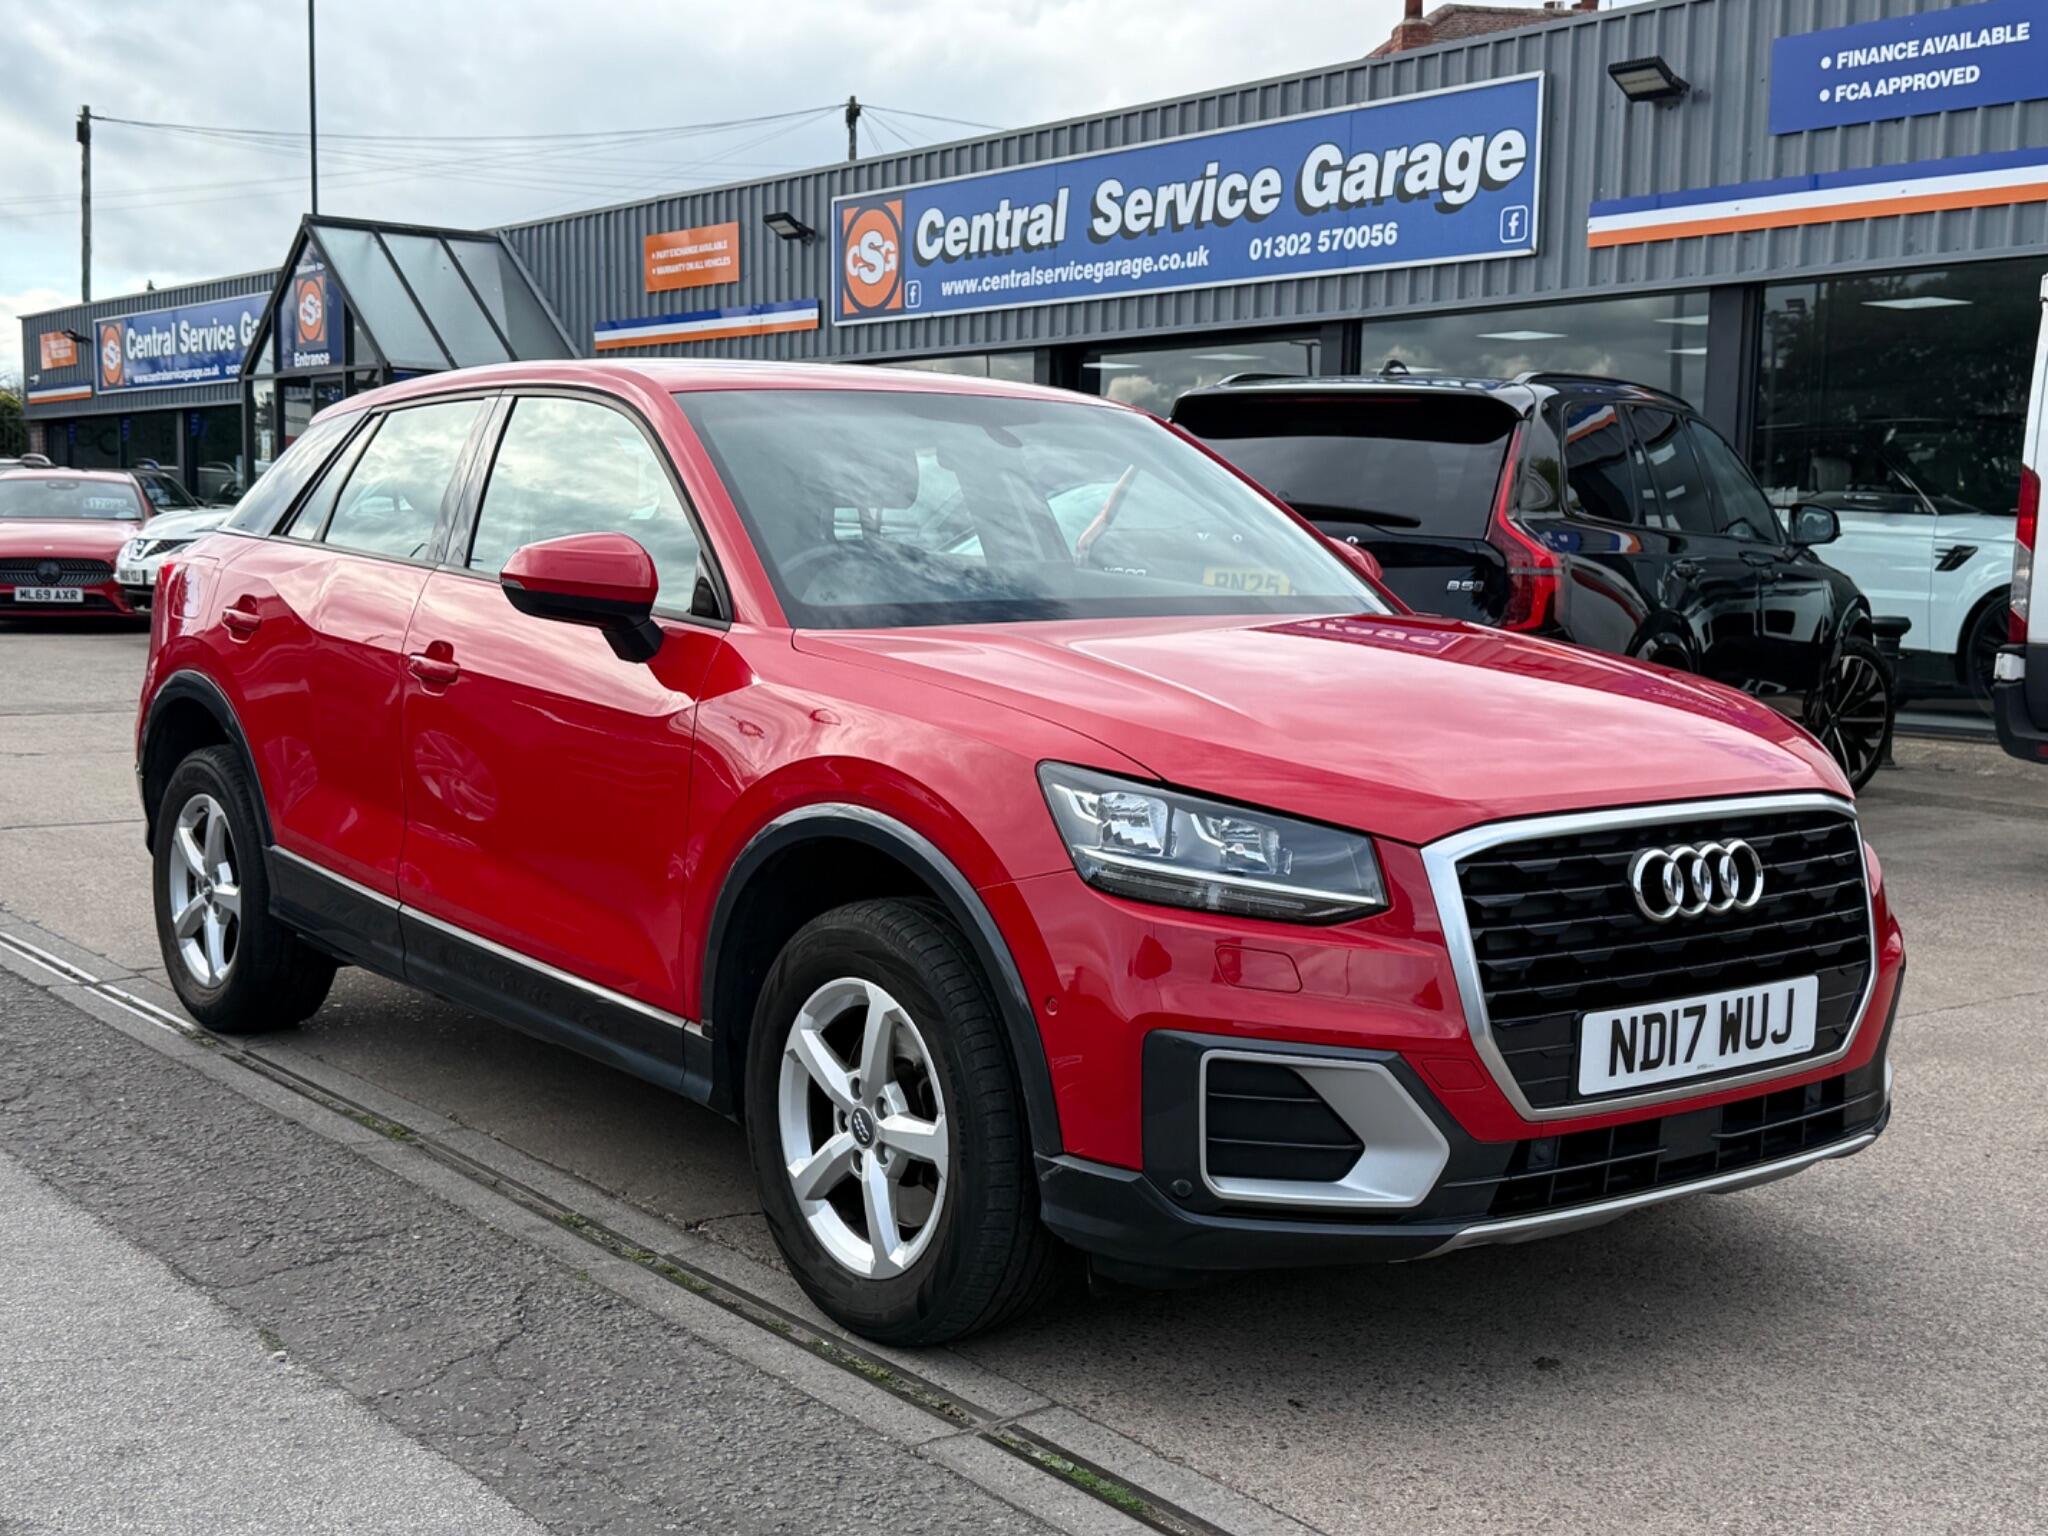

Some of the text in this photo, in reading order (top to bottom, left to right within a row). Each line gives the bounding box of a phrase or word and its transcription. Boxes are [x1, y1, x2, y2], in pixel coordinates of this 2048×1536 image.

[1836, 22, 2031, 69] FINANCE AVAILABLE
[1834, 65, 1981, 102] FCA APPROVED
[915, 128, 1528, 262] Central Service Garage
[1249, 221, 1399, 261] 01302 570056
[941, 245, 1209, 297] www.centralservicegarage.co.uk
[126, 321, 177, 360] Central
[179, 317, 236, 354] Service
[294, 352, 331, 368] Entrance
[19, 588, 78, 601] ML69 AXR
[1608, 988, 1795, 1078] ND17 WUJ
